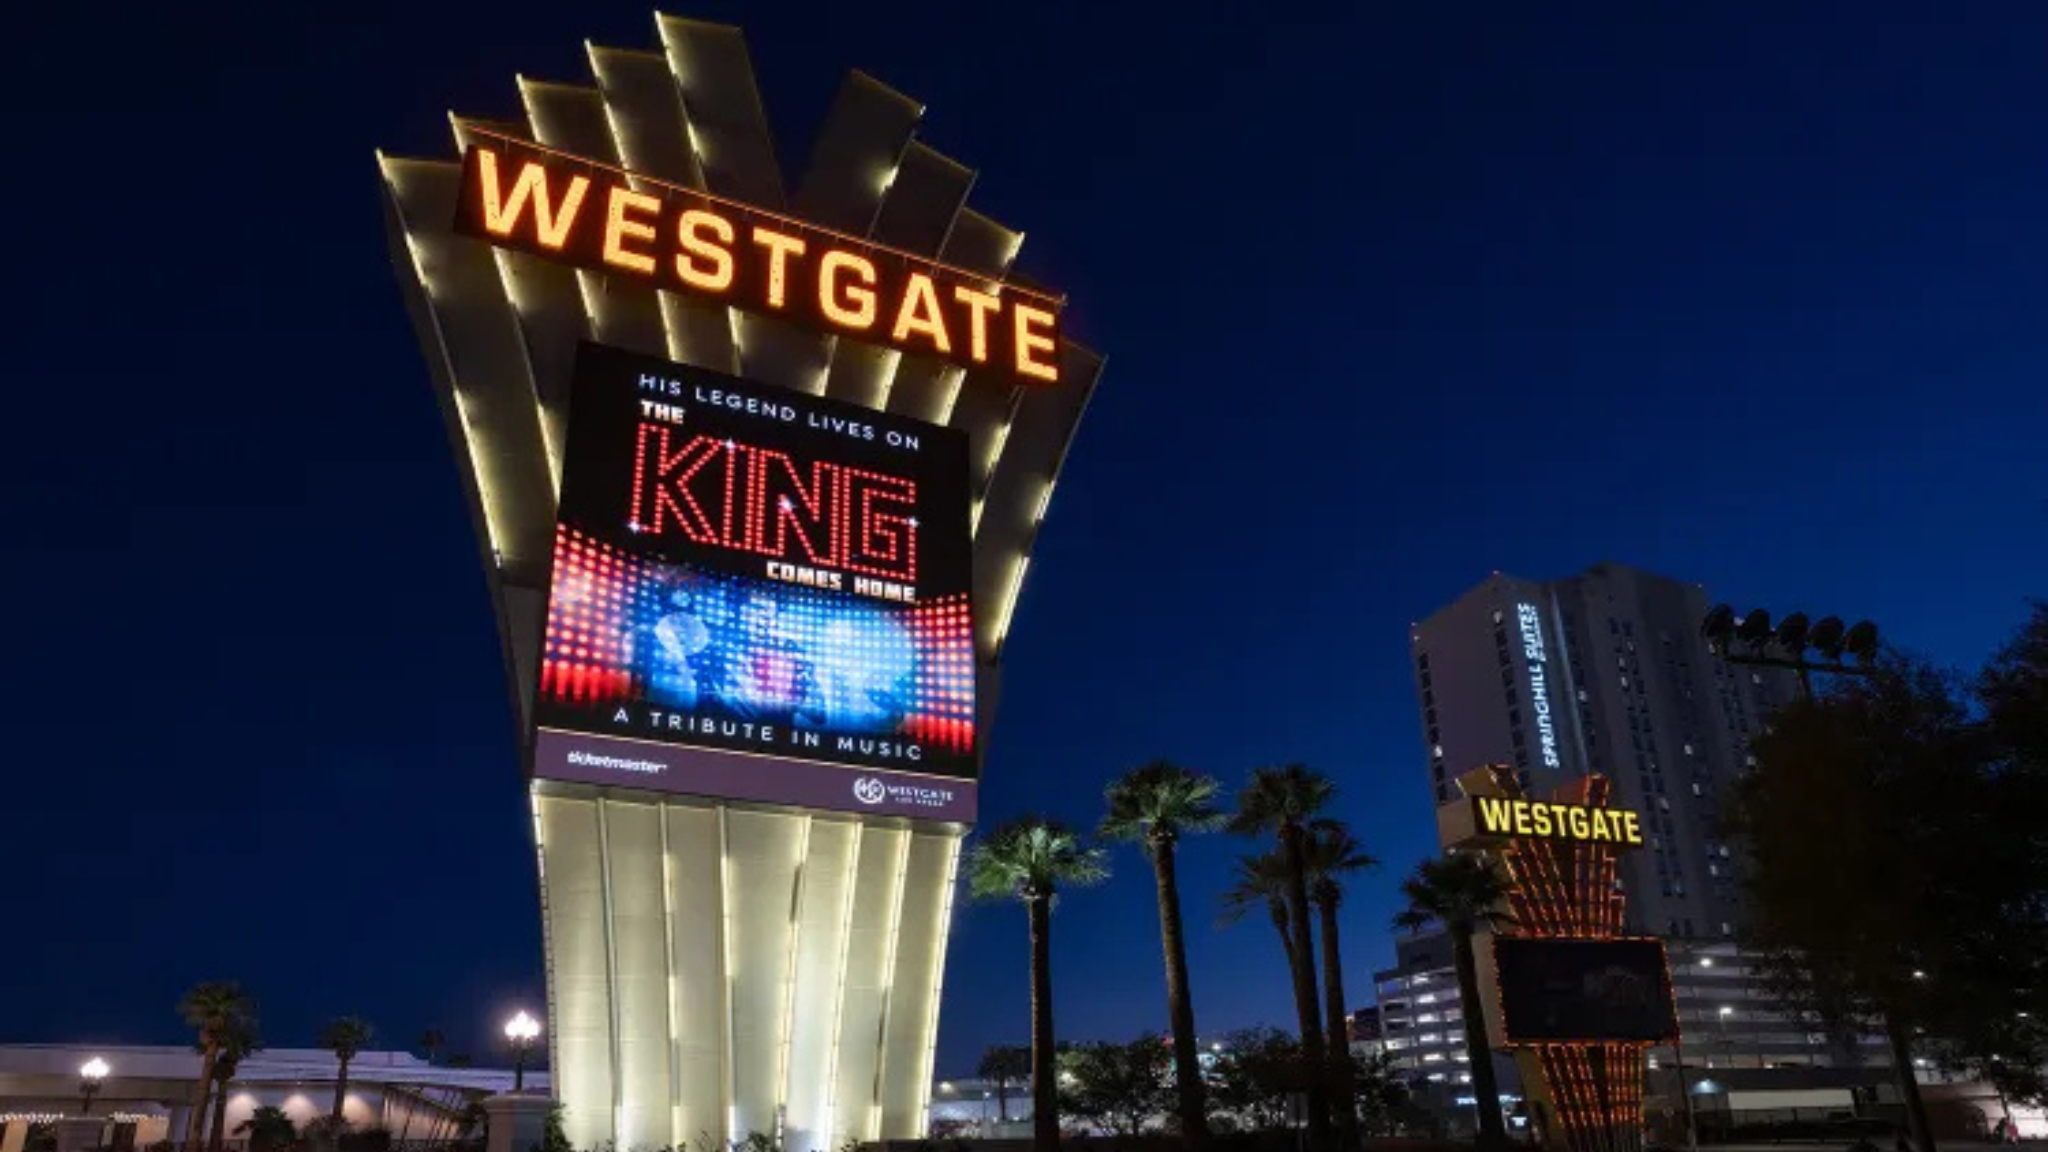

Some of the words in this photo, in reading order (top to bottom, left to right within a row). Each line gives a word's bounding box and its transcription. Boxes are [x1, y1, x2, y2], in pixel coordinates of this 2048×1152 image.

[477, 149, 1059, 382] WESTGATE
[639, 374, 681, 396] HIS
[695, 387, 796, 422] LEGEND
[808, 412, 875, 441] LIVES
[886, 430, 919, 450] ON
[641, 400, 685, 424] THE
[630, 422, 917, 581] KING
[766, 560, 843, 591] COMES
[854, 576, 917, 603] HOME
[1517, 603, 1539, 660] SUITES
[613, 707, 629, 723] A
[650, 711, 774, 742] TRIBUTE
[791, 731, 820, 747] IN
[837, 736, 922, 761] MUSIC
[1528, 663, 1561, 769] SPRINGHILL
[1479, 797, 1643, 844] WESTGATE
